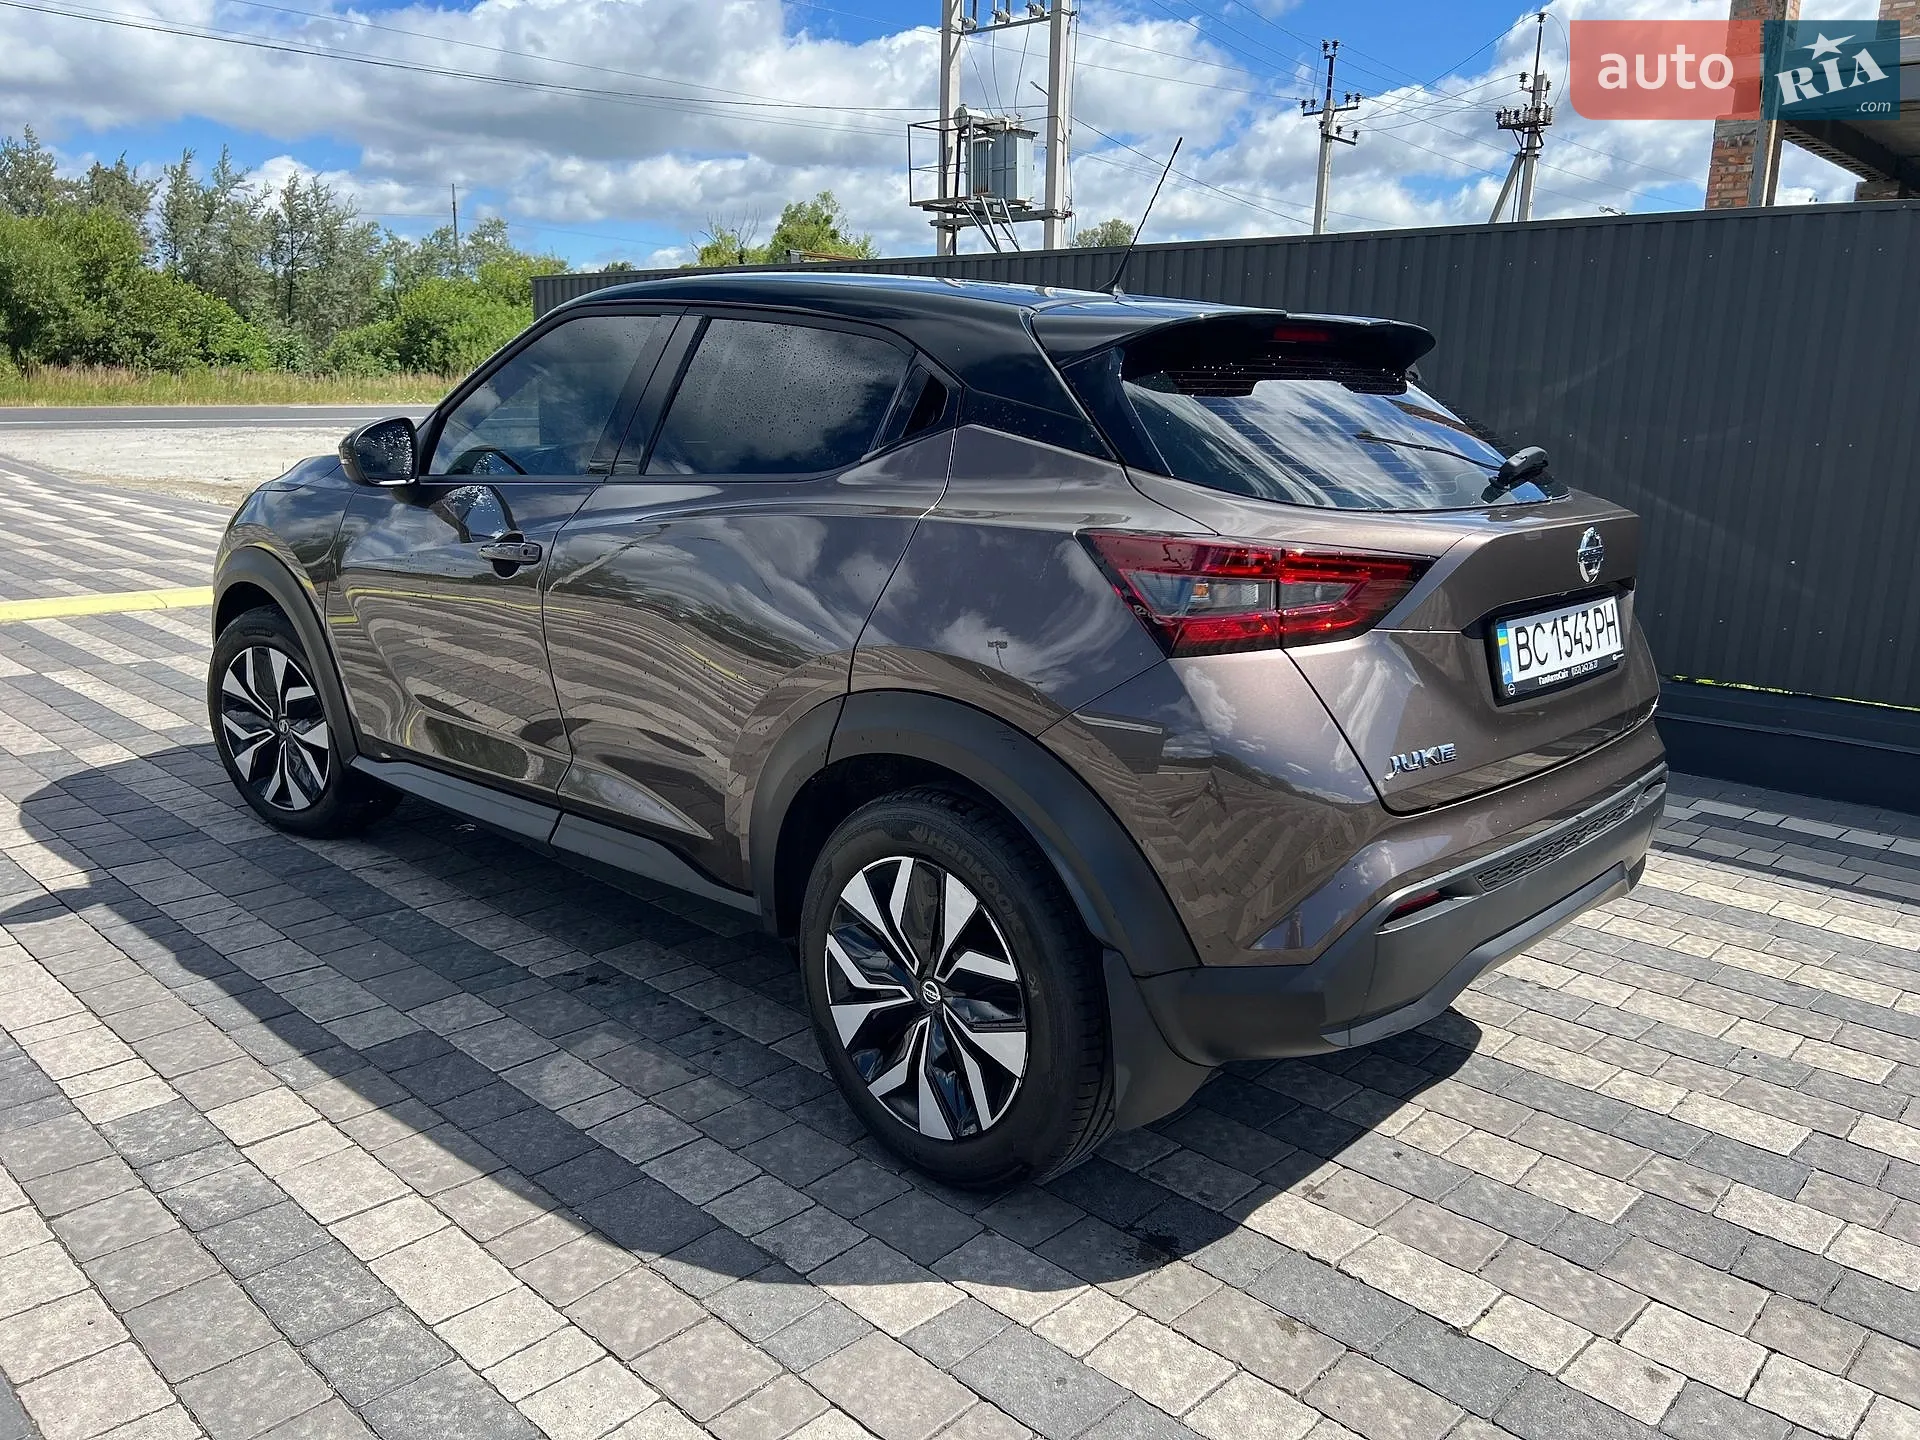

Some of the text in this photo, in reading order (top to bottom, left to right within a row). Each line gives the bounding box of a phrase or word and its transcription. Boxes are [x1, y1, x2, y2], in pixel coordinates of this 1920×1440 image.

[1515, 603, 1618, 672] BC 1543 PH
[1384, 743, 1457, 781] JUKE
